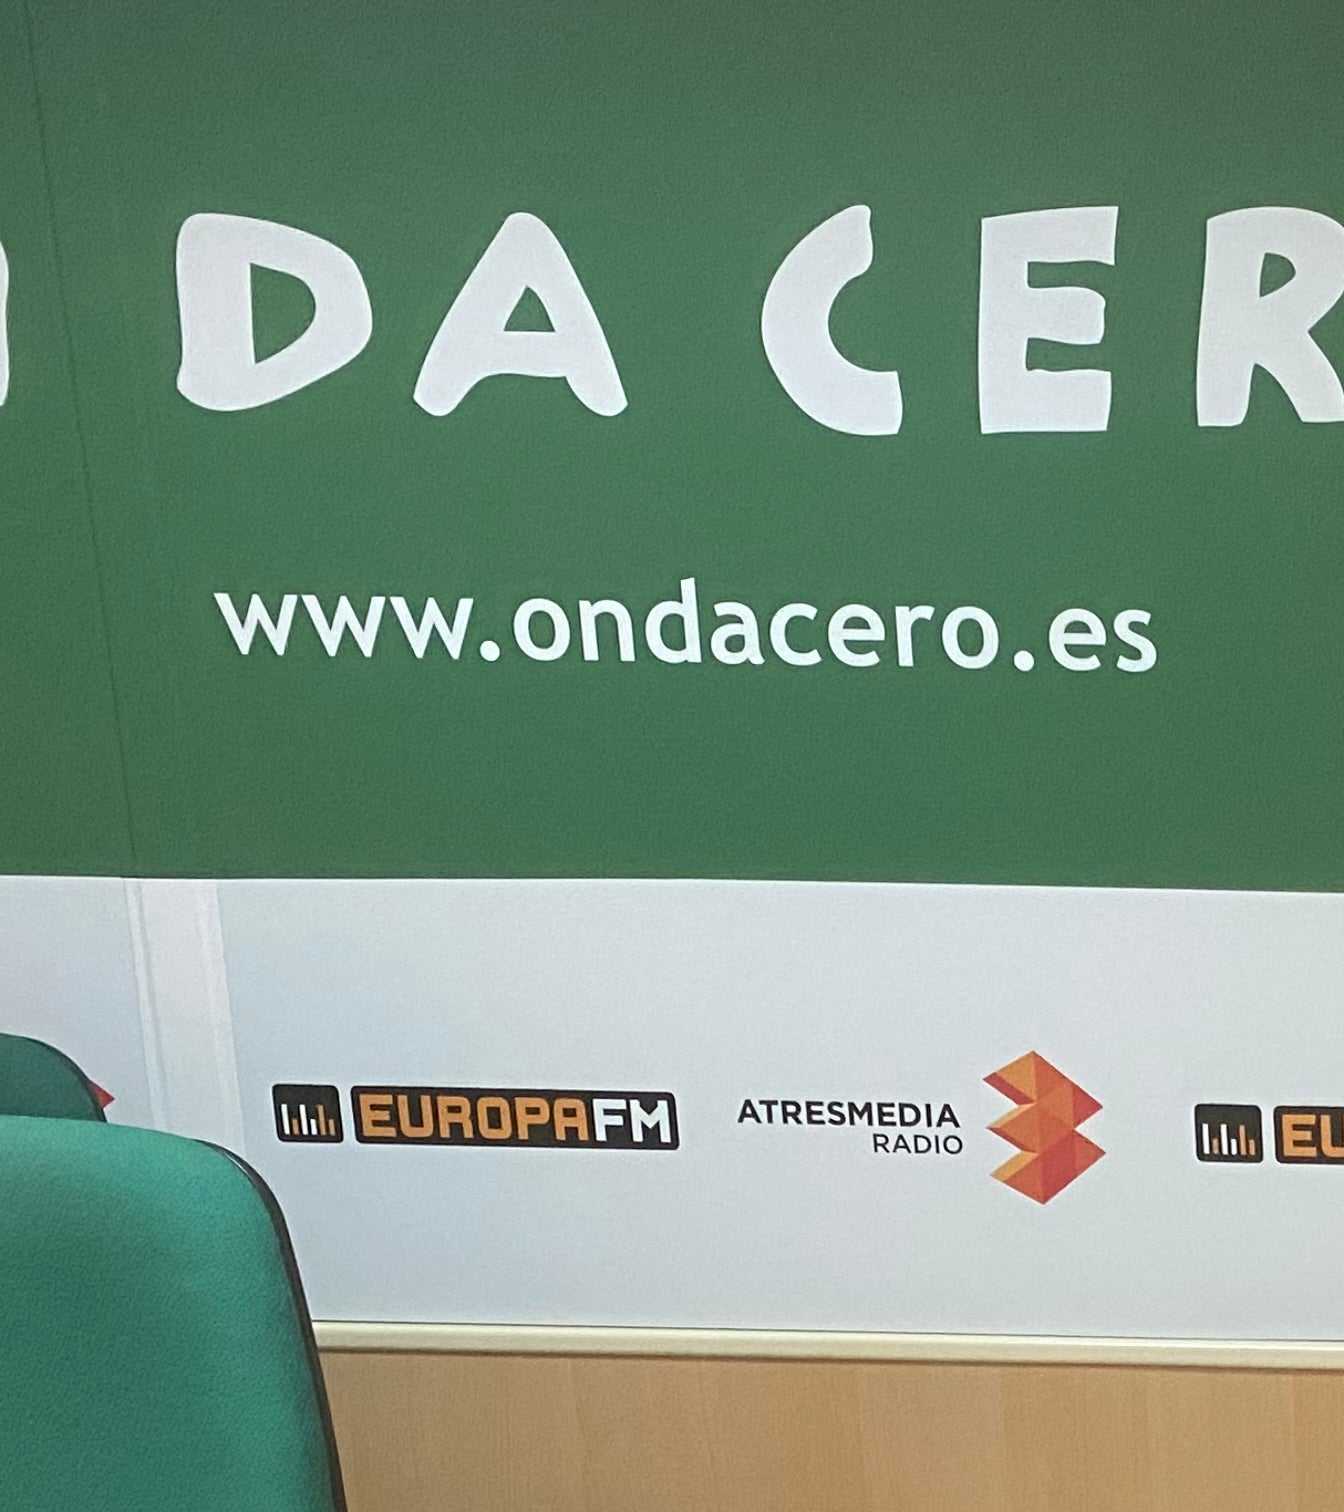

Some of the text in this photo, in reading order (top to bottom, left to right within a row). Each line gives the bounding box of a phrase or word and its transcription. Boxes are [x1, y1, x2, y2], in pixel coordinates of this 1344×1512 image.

[0, 212, 629, 417] DA
[213, 576, 1158, 673] www.ondacero.es
[736, 1098, 961, 1129] ATRESMEDIA
[873, 1133, 963, 1156] RADIO
